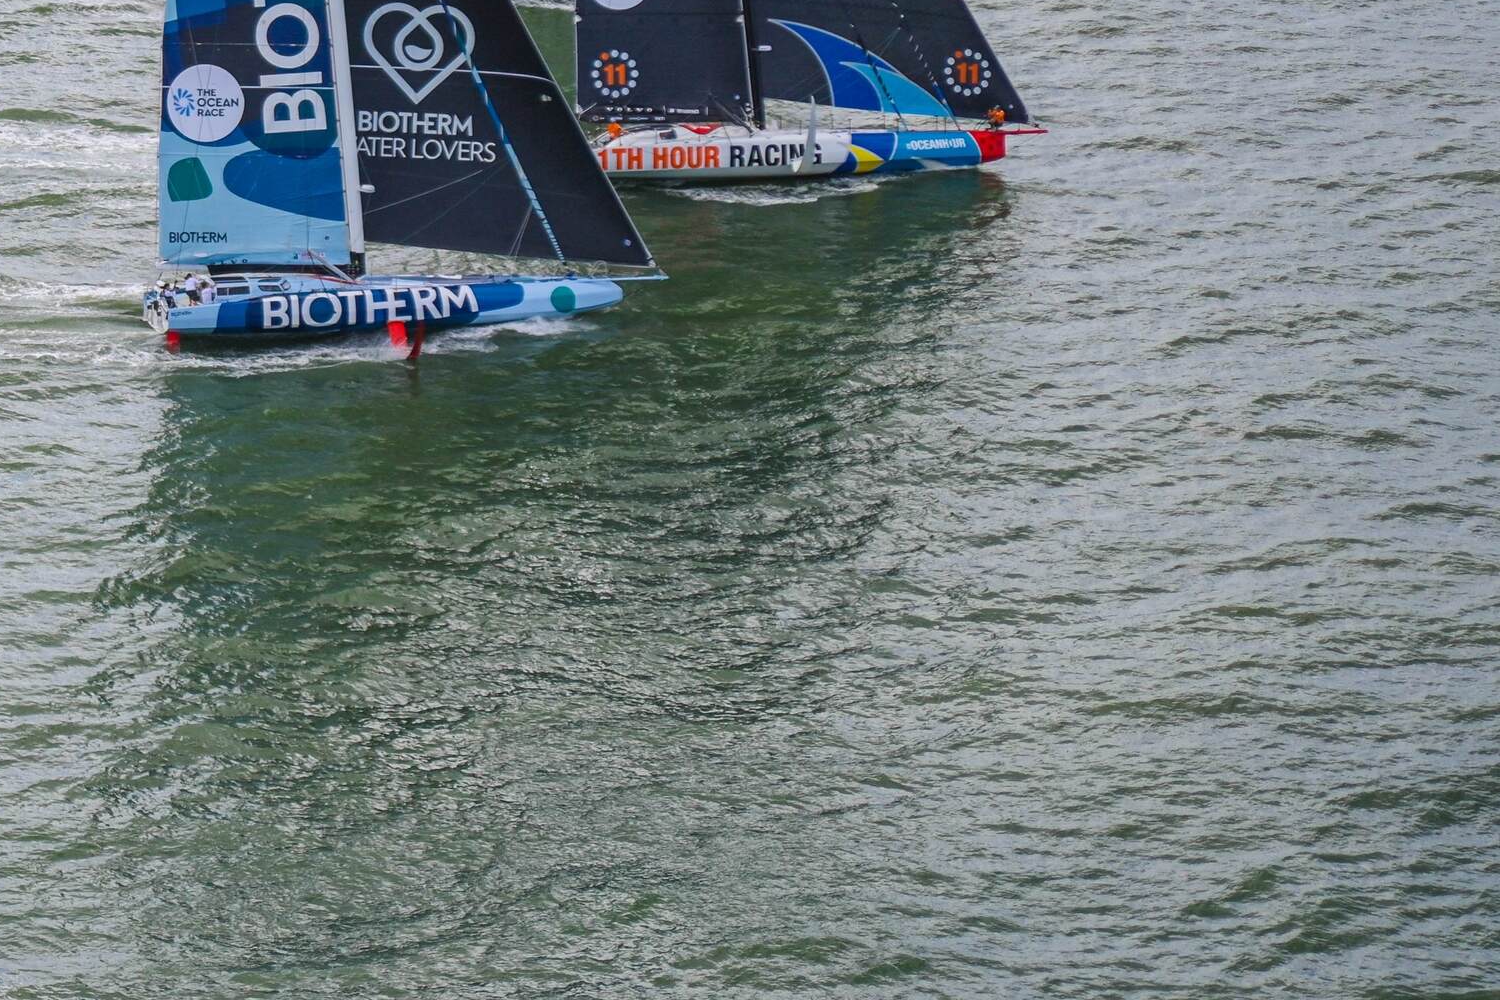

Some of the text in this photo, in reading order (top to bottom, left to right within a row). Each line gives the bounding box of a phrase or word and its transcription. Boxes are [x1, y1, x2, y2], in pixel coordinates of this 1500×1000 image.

[603, 63, 627, 86] 11
[956, 62, 979, 85] 11
[196, 88, 217, 97] THE
[196, 98, 239, 107] OCEAN
[196, 109, 225, 117] RACE
[358, 110, 473, 137] BIOTHERM
[356, 135, 497, 164] ATER LOVERS
[653, 145, 720, 170] HOUR
[168, 231, 228, 244] BIOTHERM
[262, 284, 480, 330] BIOTHERM
